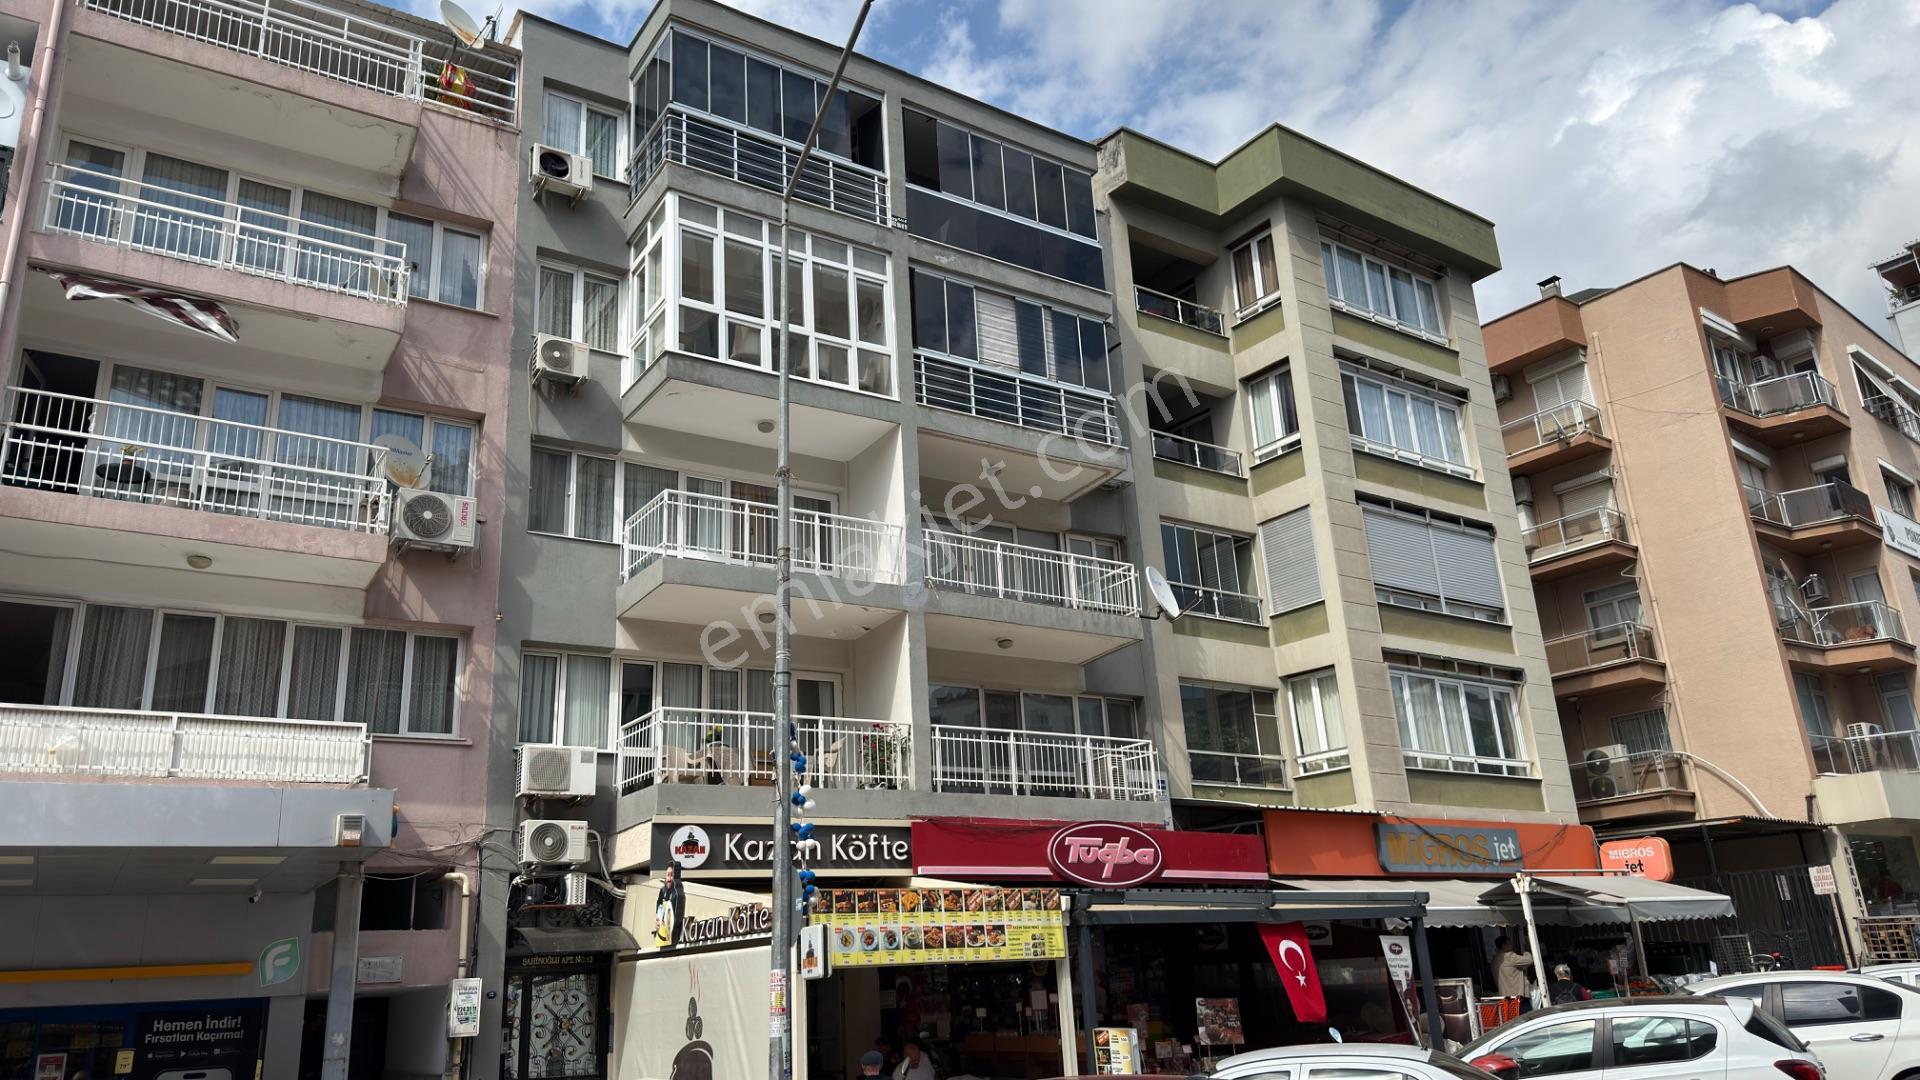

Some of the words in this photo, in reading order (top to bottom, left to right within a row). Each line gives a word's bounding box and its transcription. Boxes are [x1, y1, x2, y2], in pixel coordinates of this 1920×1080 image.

[831, 832, 909, 861] Köfte
[1493, 836, 1517, 866] jet
[680, 916, 724, 943] Kazan
[728, 903, 769, 935] Köfte
[153, 1019, 203, 1032] Hemen
[205, 1014, 242, 1029] İndir!
[196, 1029, 244, 1043] Kaçırma!
